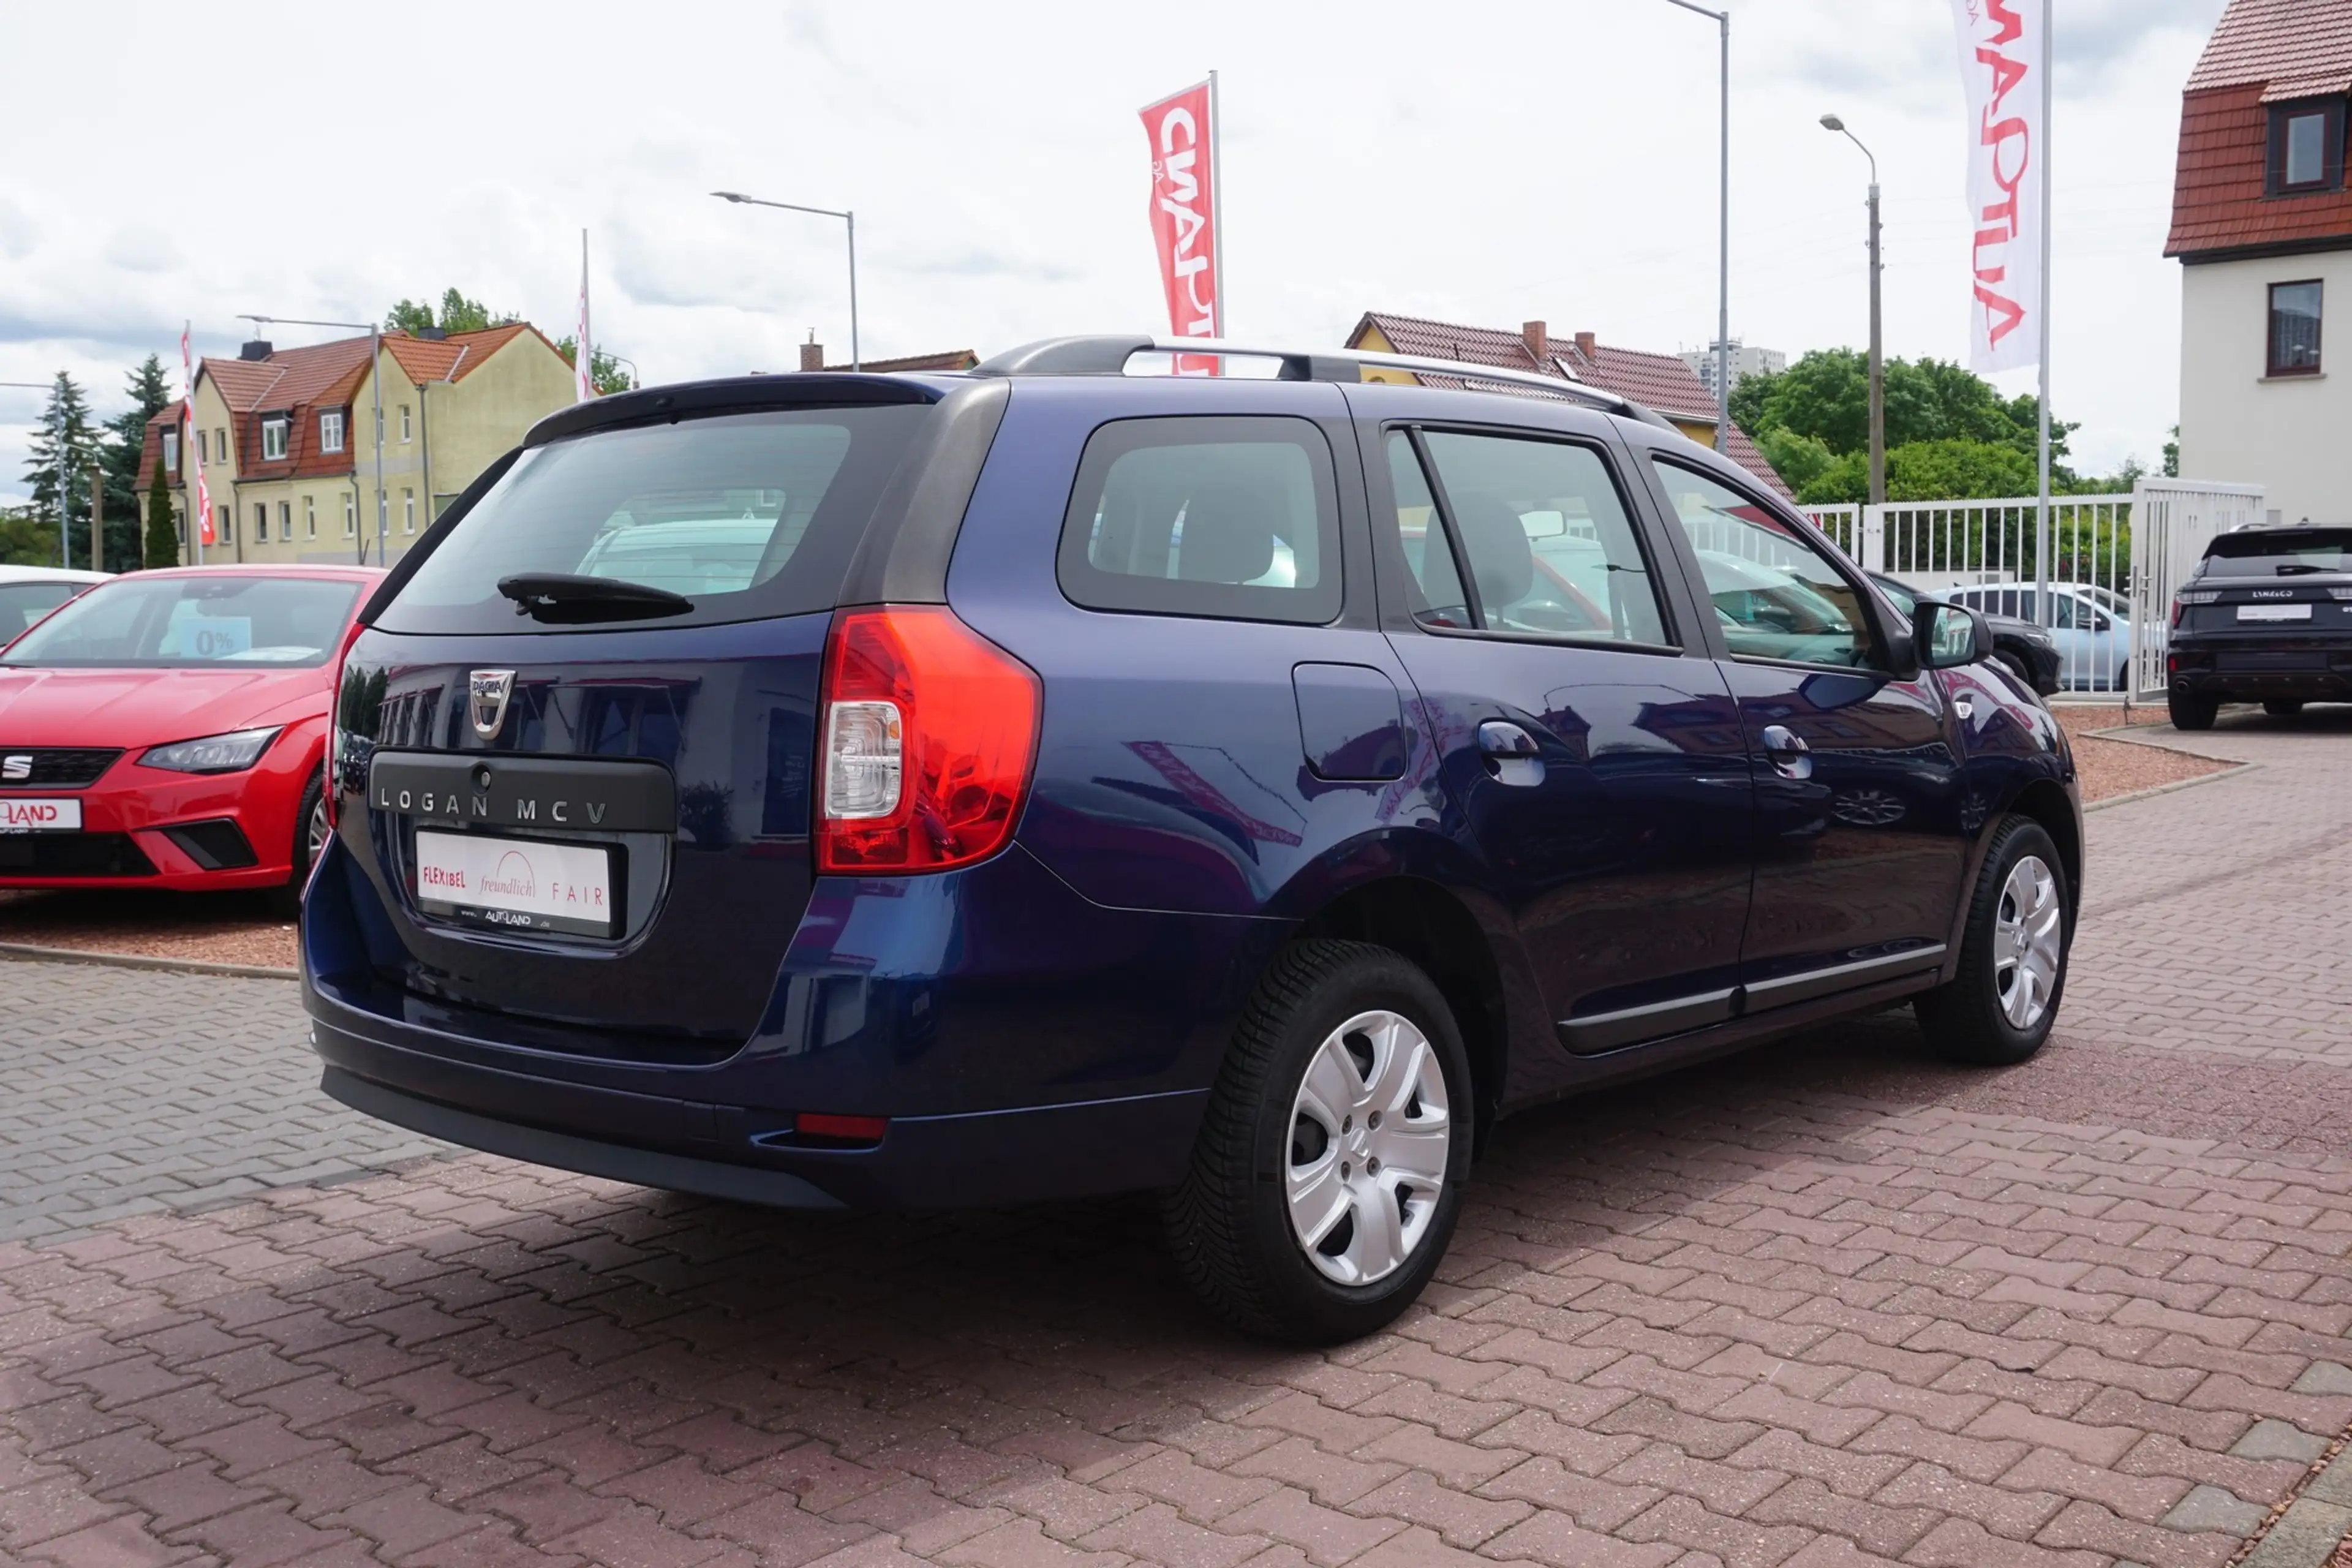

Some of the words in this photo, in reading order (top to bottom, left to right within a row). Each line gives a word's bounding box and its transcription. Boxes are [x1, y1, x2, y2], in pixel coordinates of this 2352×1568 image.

[196, 630, 233, 655] 0%
[473, 680, 504, 693] DACIA
[381, 788, 488, 816] LOGAN
[423, 865, 466, 888] FLEXIBEL
[478, 874, 536, 898] freundlich
[552, 882, 603, 906] FAIR
[485, 911, 531, 925] AUTOLAND
